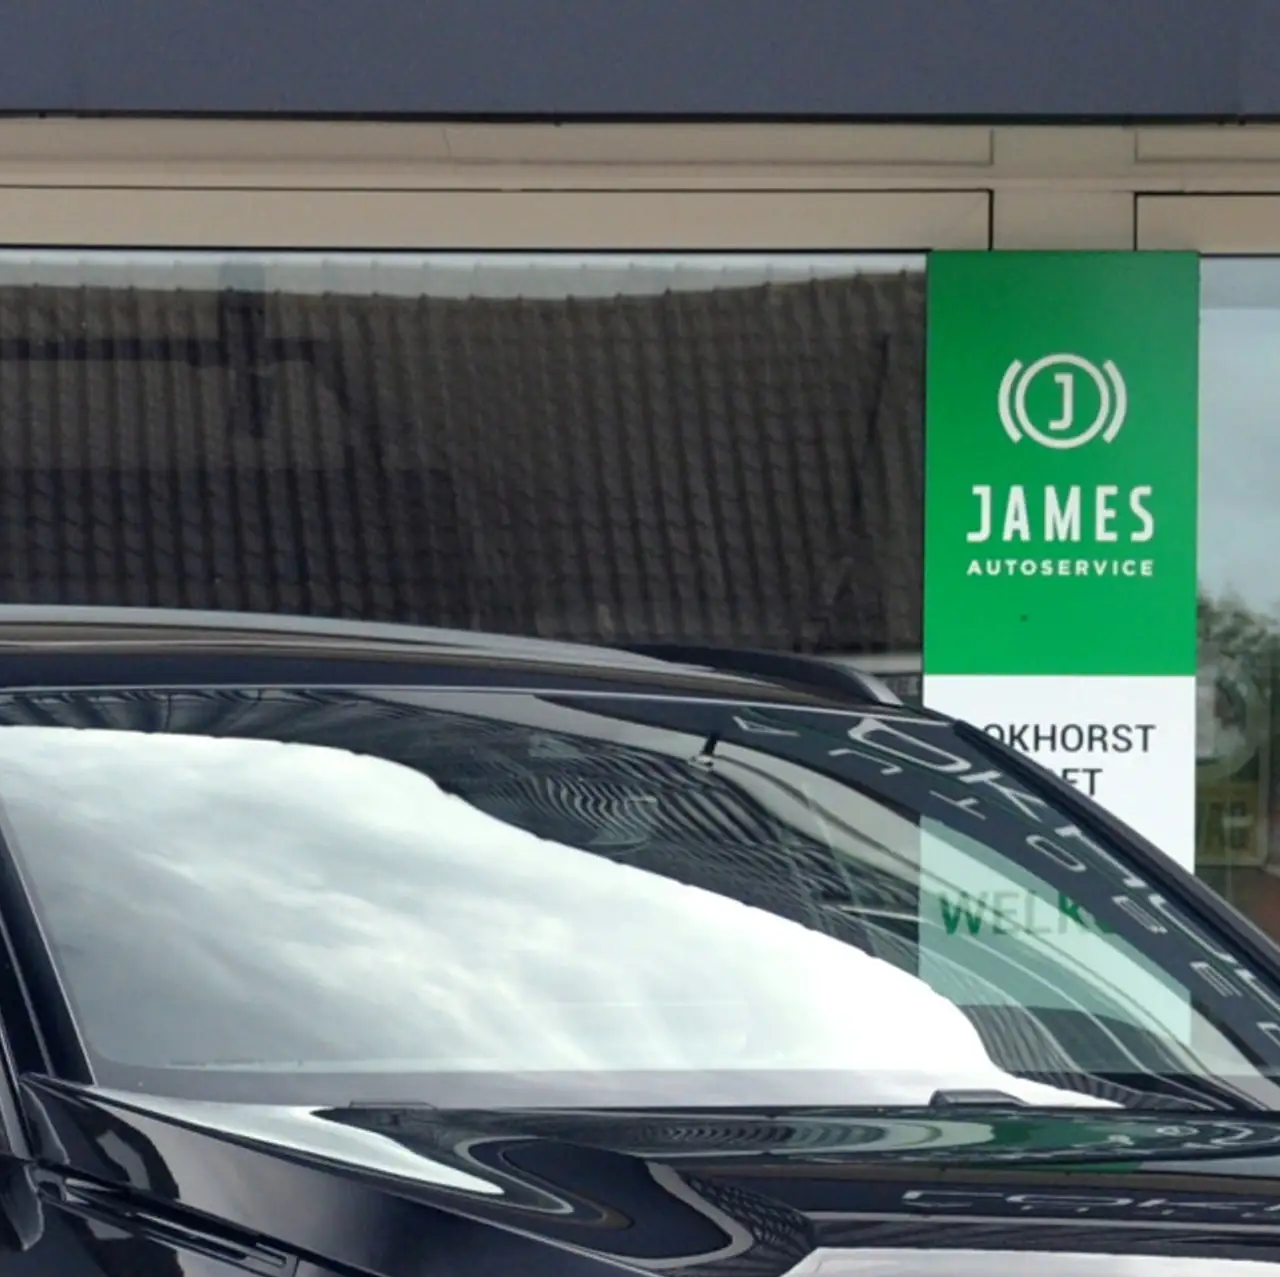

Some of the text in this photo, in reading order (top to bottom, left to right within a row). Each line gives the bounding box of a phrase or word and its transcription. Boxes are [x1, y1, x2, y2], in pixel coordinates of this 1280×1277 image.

[966, 485, 1155, 542] JAMES
[966, 559, 1154, 576] AUTOSERVICE
[982, 724, 1156, 752] OKHORST
[938, 890, 1116, 936] WELK
